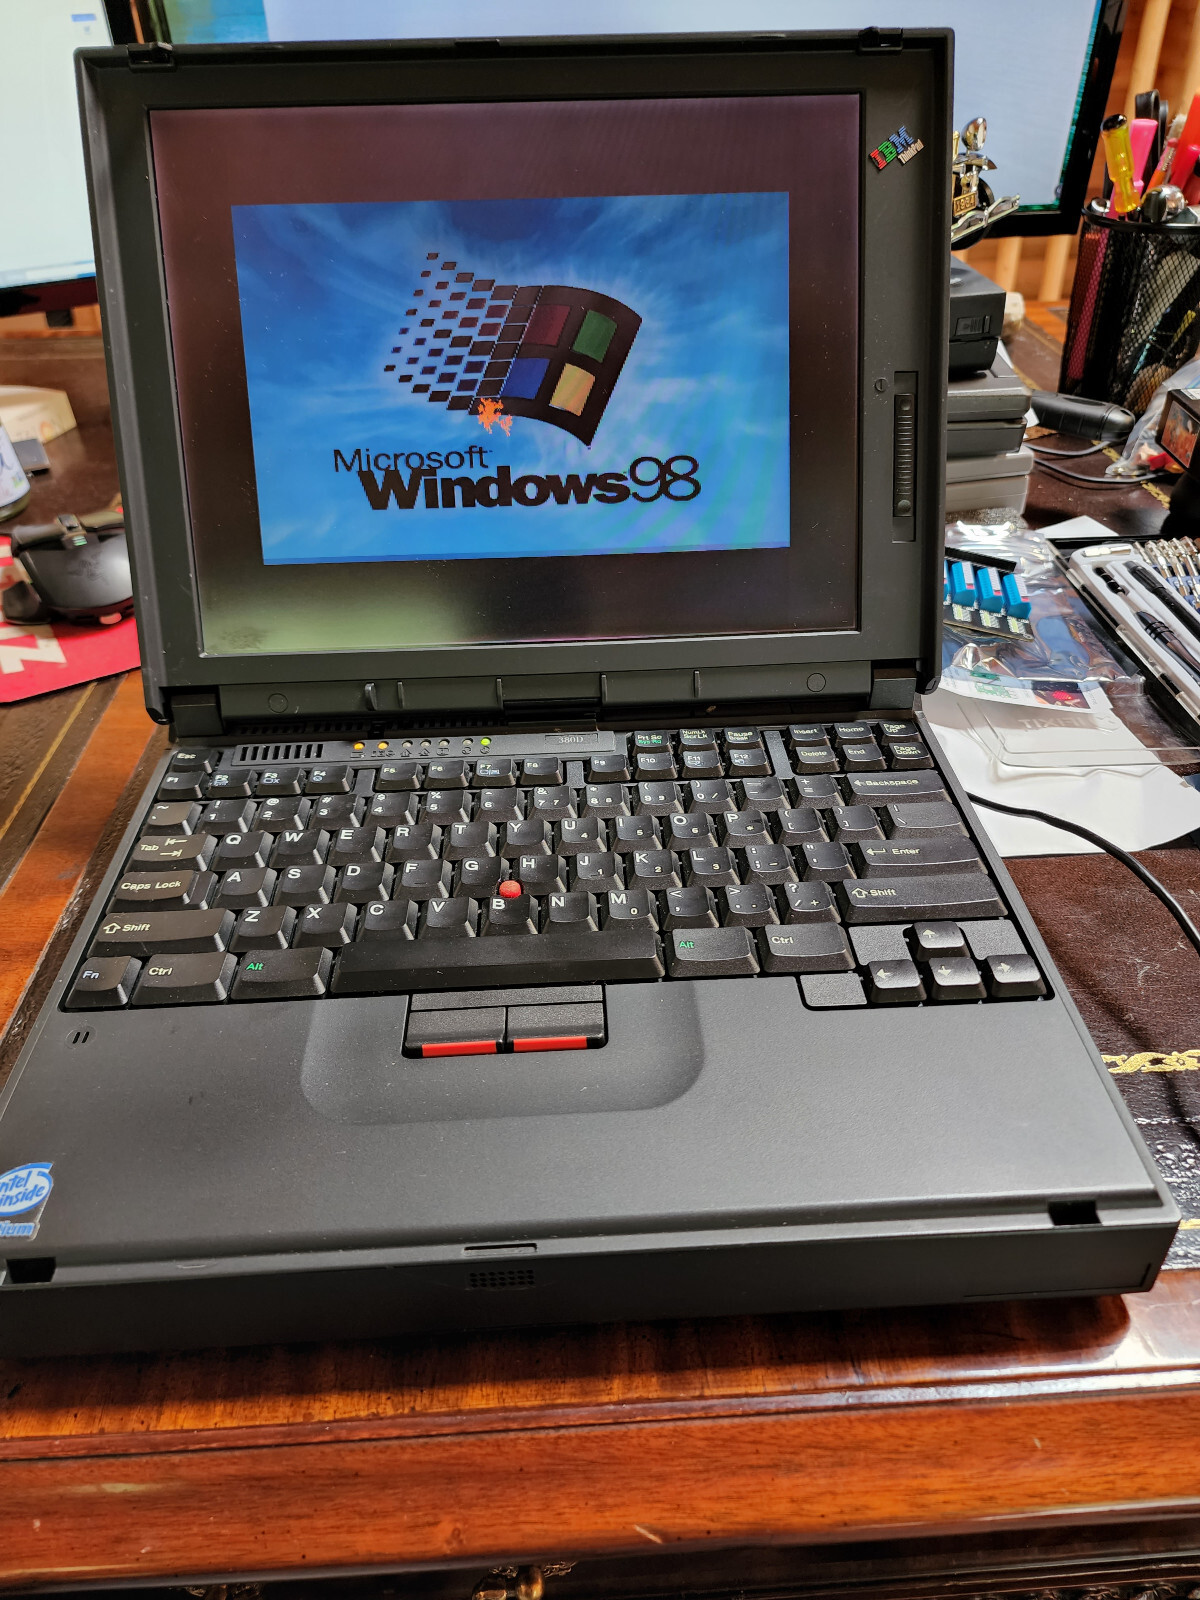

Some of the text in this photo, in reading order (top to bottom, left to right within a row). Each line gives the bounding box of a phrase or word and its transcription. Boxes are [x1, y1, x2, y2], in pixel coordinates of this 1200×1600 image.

[870, 126, 914, 170] IBM
[333, 445, 489, 472] Microsoft
[558, 736, 584, 744] 380D
[618, 818, 624, 827] I
[673, 815, 687, 824] O
[727, 813, 739, 822] P
[454, 824, 467, 835] T
[509, 822, 523, 832] Y
[564, 820, 576, 830] U
[340, 829, 353, 839] E
[396, 826, 411, 836] R
[225, 834, 242, 845] Q
[284, 832, 304, 842] W
[140, 843, 159, 851] Tab
[891, 847, 920, 855] Enter
[579, 855, 589, 866] J
[635, 852, 648, 863] K
[692, 850, 705, 861] L
[405, 862, 418, 873] F
[464, 860, 479, 871] G
[522, 858, 535, 868] H
[288, 868, 301, 879] S
[347, 865, 361, 876] D
[226, 871, 242, 882] A
[121, 879, 181, 891] Caps Lock
[869, 888, 897, 896] Shift
[492, 898, 506, 910] B
[551, 896, 565, 907] N
[610, 893, 627, 904] M
[369, 904, 385, 915] C
[432, 901, 446, 913] V
[244, 910, 260, 922] Z
[306, 907, 323, 919] X
[122, 922, 151, 932] Shift
[679, 939, 695, 949] Alt
[771, 935, 794, 945] Ctrl
[149, 966, 173, 976] Ctrl
[246, 962, 264, 971] Alt
[82, 970, 100, 980] Fn
[0, 1170, 33, 1193] ntel
